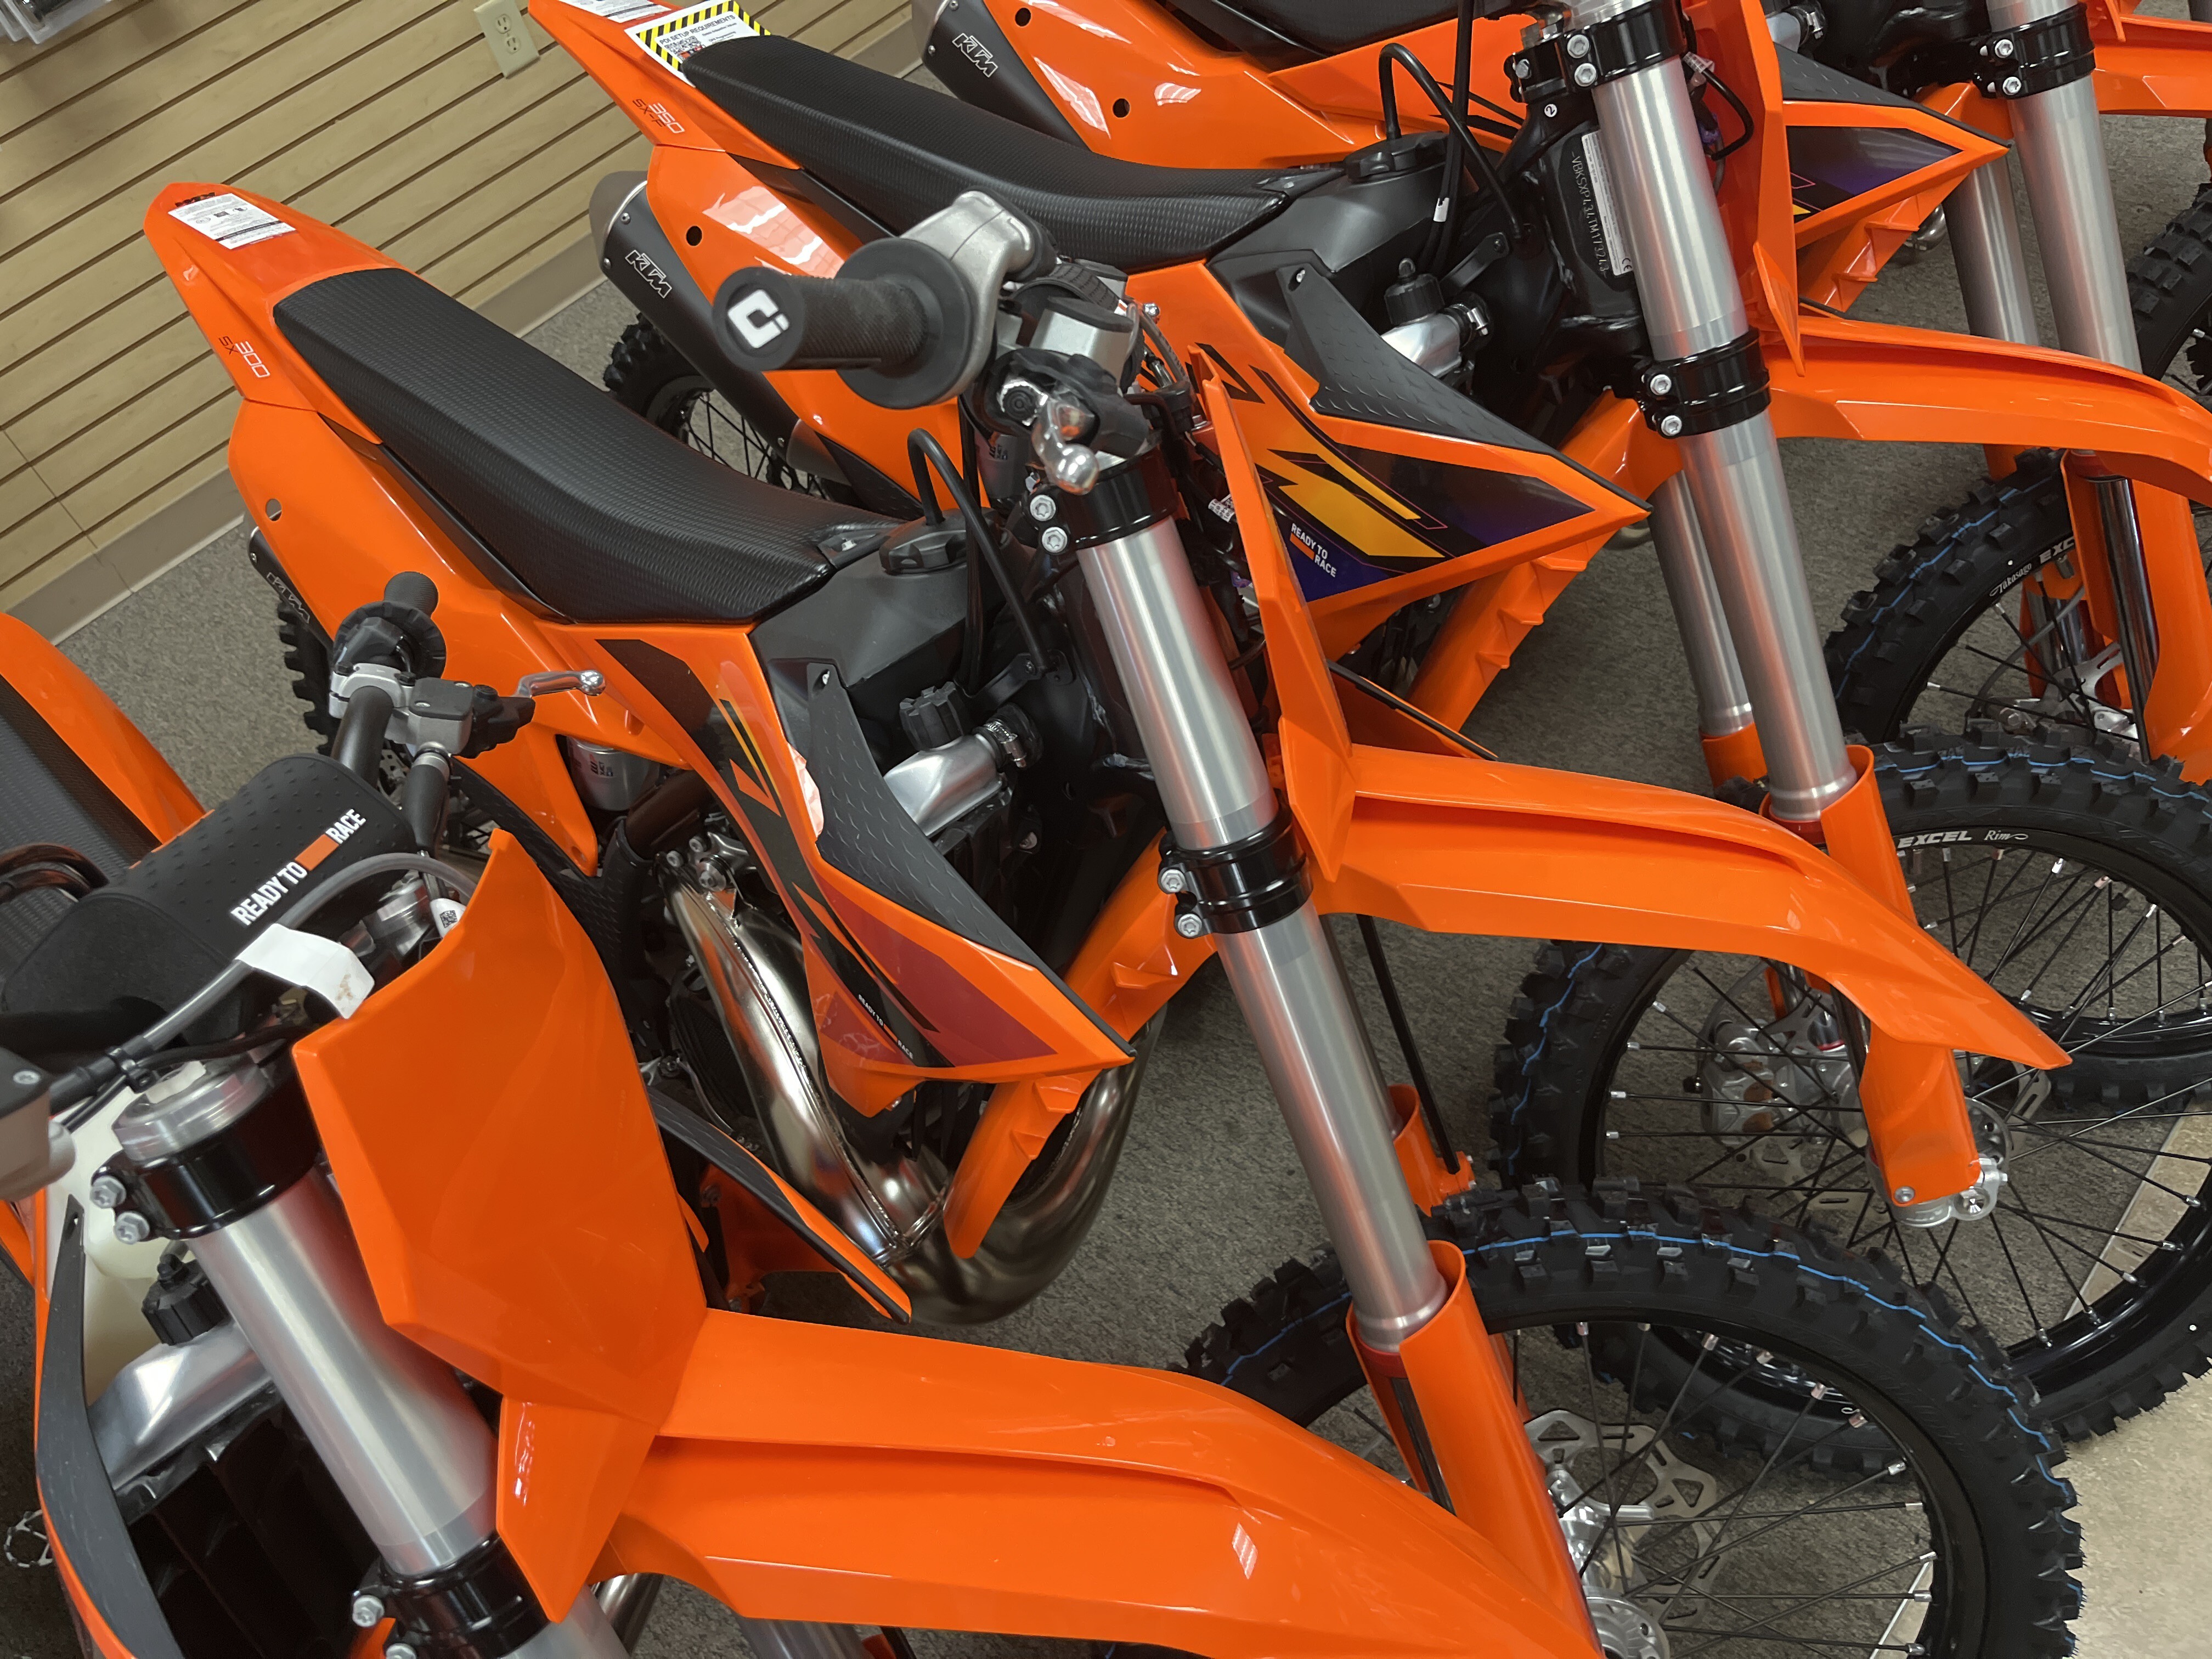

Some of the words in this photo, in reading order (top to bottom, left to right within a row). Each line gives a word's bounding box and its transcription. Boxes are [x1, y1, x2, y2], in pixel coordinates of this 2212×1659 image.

[690, 15, 736, 33] REQUIREMENTS
[952, 33, 998, 77] KTM
[632, 99, 666, 127] SX-F
[648, 102, 685, 133] 350
[625, 250, 672, 298] KTM
[218, 336, 239, 356] SX
[235, 341, 270, 377] 300
[1291, 523, 1317, 549] READY
[1317, 544, 1328, 560] TO
[1314, 554, 1336, 578] RACE
[1897, 830, 1973, 849] EXCEL
[230, 876, 289, 926] READY
[276, 861, 308, 884] TO
[325, 809, 366, 844] RACE
[859, 994, 876, 1016] READY
[876, 1014, 883, 1026] TO
[898, 1040, 913, 1059] RACE
